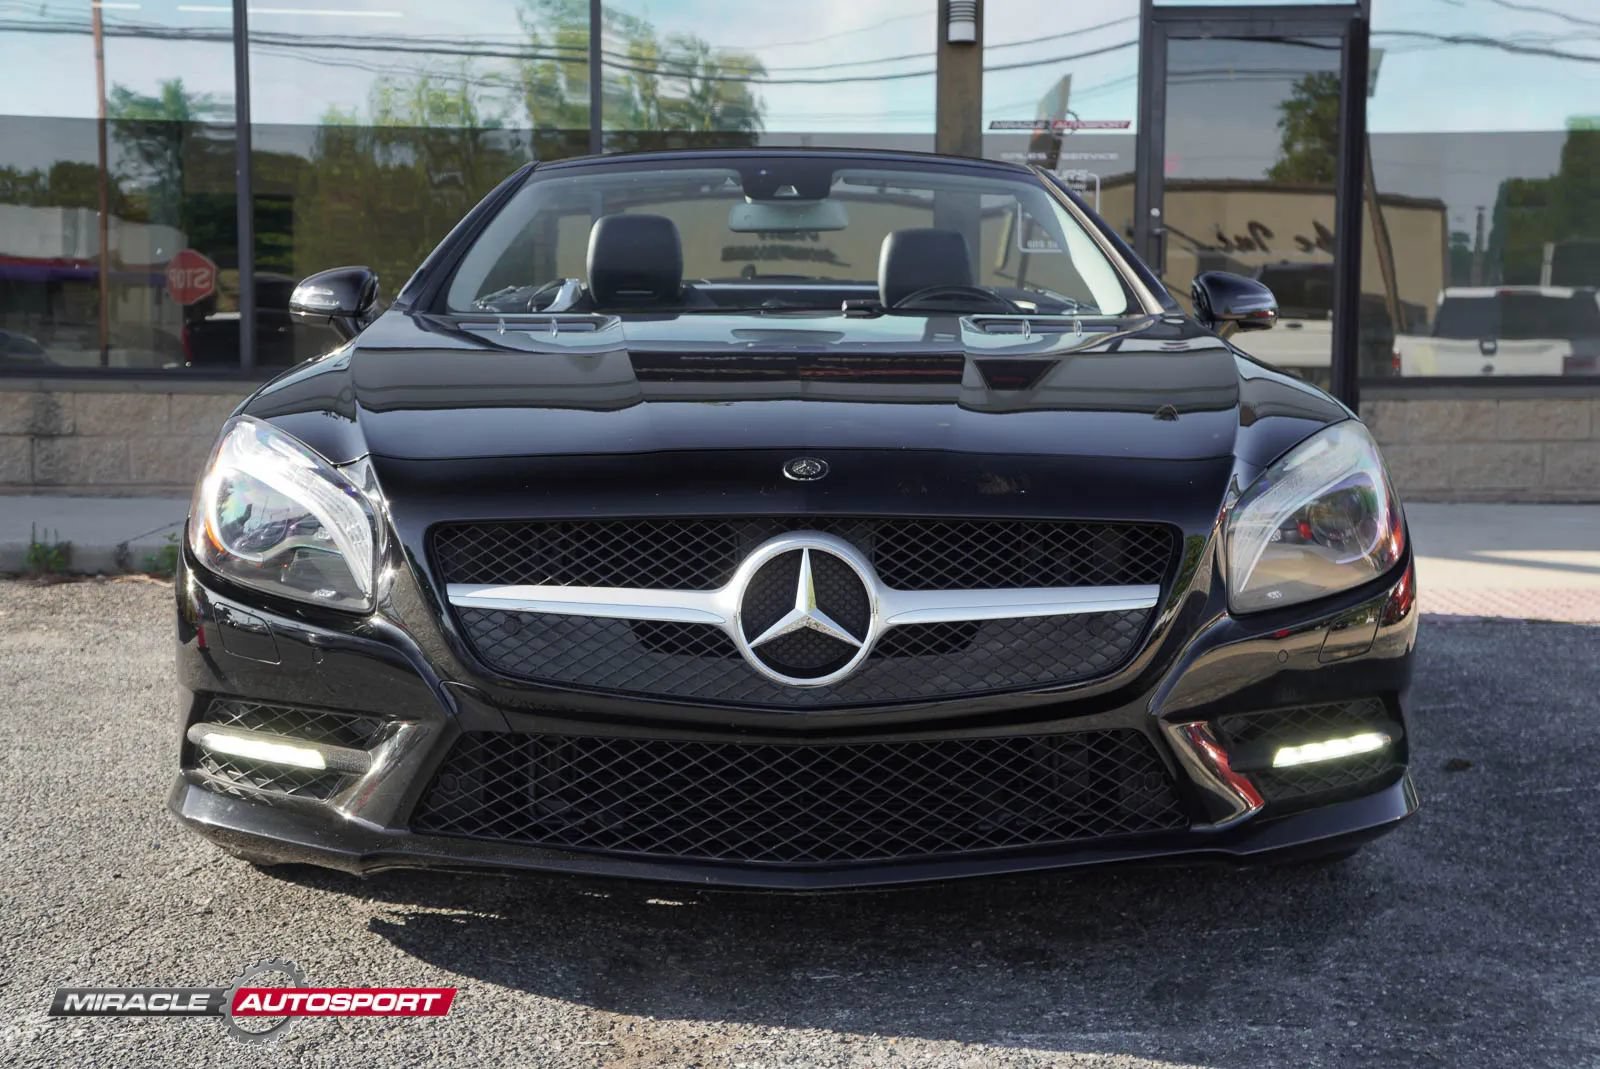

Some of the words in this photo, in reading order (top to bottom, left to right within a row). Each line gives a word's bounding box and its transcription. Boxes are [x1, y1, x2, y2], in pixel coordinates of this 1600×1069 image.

[991, 121, 1045, 129] MIRACLE
[1054, 121, 1128, 129] AUTOSPORT
[1061, 152, 1119, 160] SERVICE
